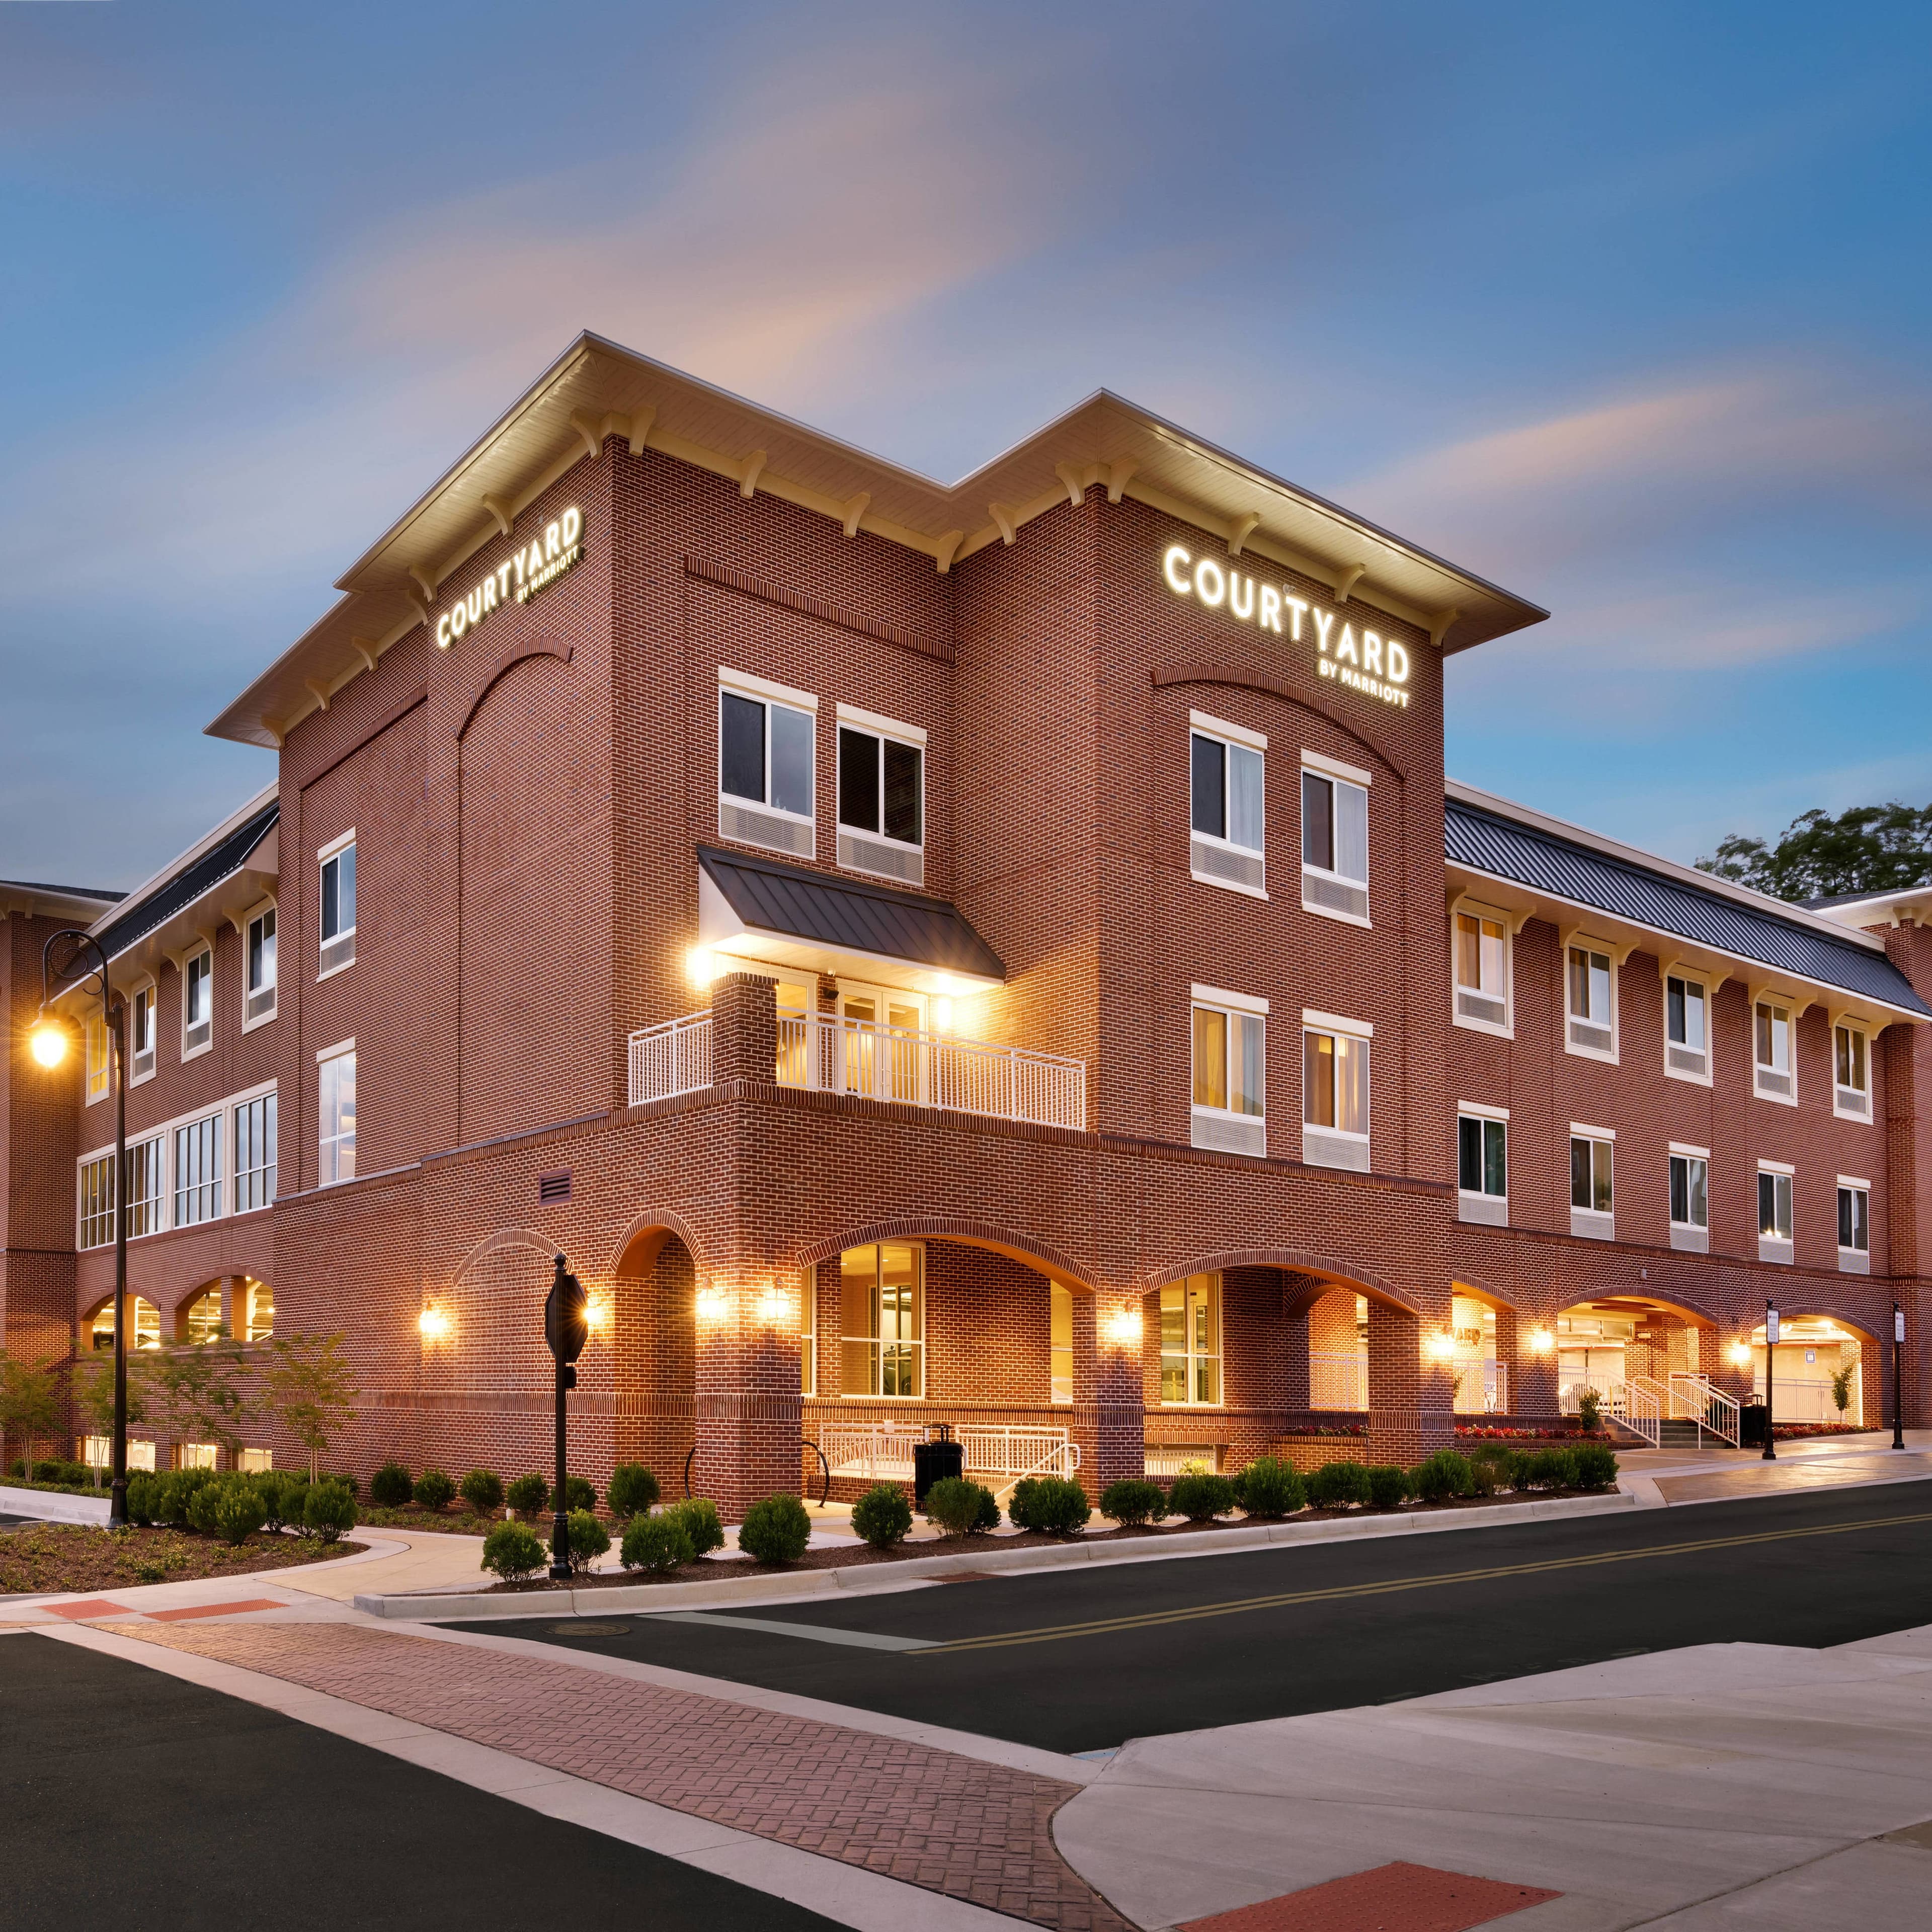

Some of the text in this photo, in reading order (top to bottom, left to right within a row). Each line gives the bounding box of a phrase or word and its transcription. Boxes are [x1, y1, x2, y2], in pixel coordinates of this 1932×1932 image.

[438, 508, 579, 647] COURTYARD
[517, 545, 578, 603] BY MARRIOTT
[1165, 547, 1409, 683] COURTYARD
[1320, 659, 1409, 707] BY MARRIOTT
